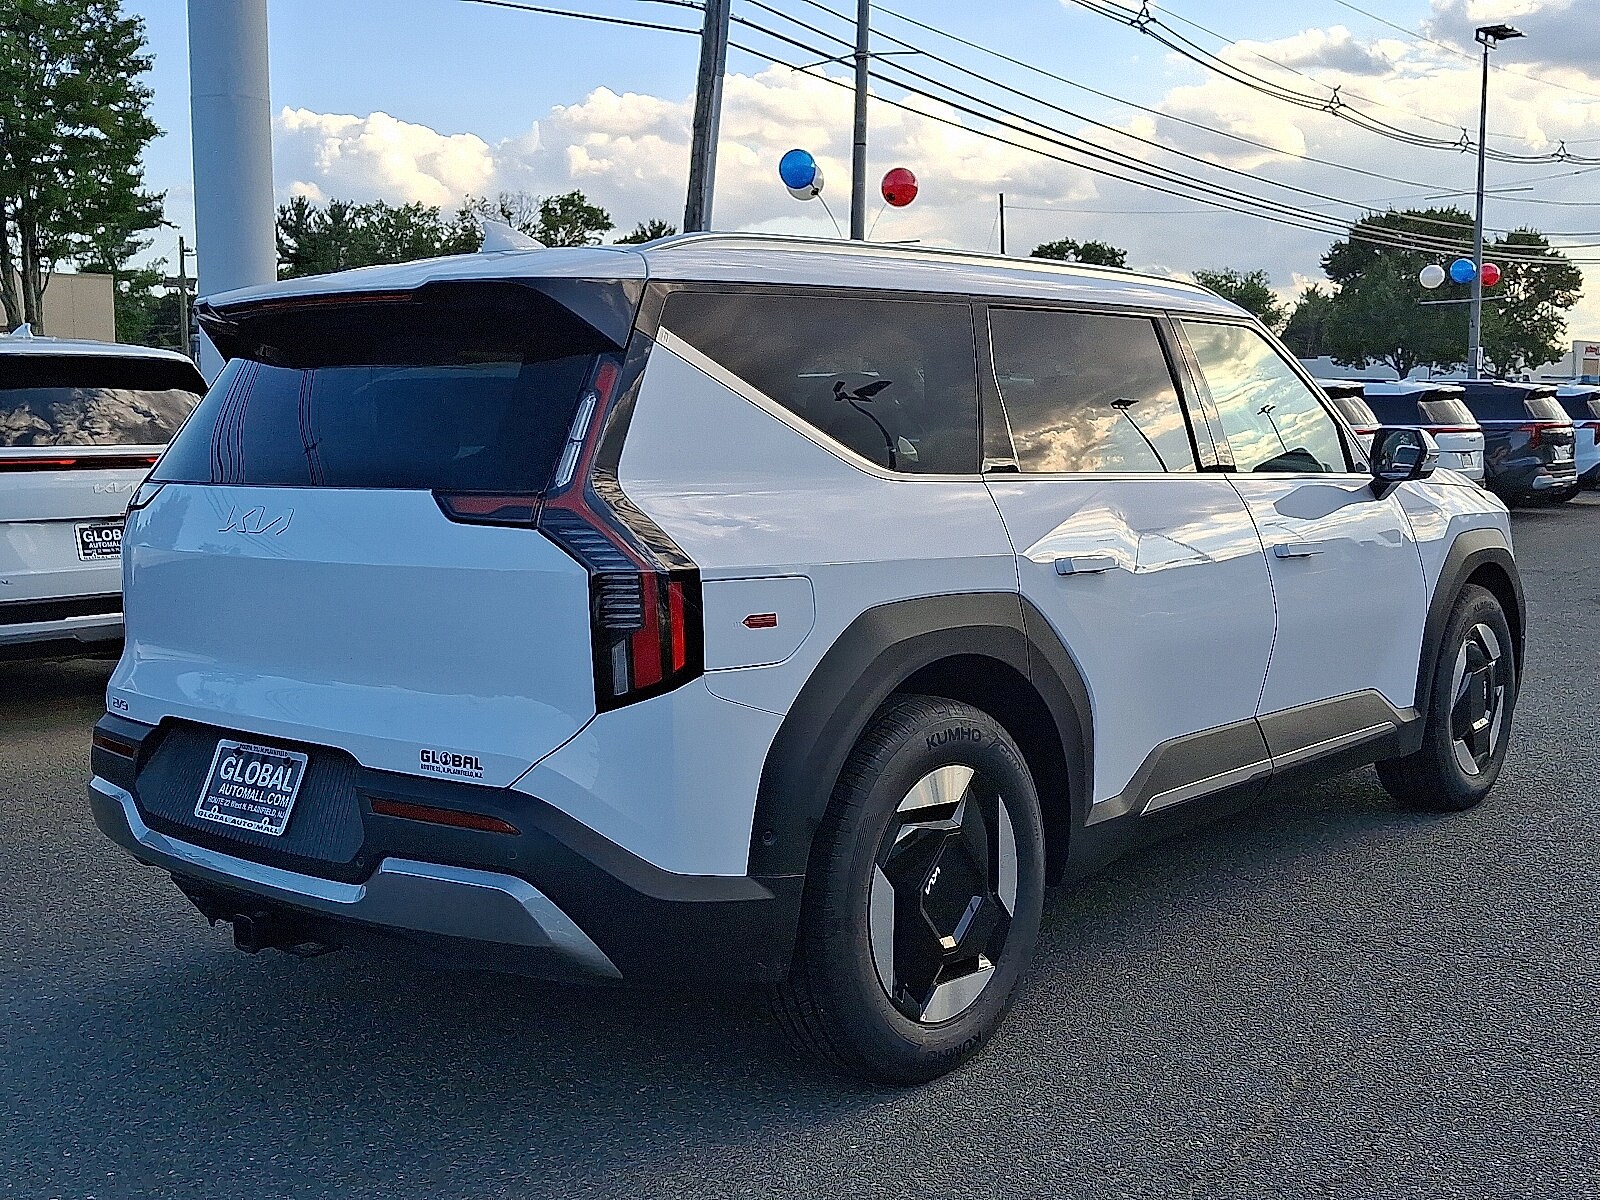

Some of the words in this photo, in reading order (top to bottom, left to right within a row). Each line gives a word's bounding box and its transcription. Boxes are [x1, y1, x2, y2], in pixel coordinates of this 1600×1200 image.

[218, 505, 296, 536] KIA
[82, 528, 122, 543] GLOB
[925, 726, 982, 752] KUMHO
[419, 748, 484, 771] GLOBAL
[220, 756, 293, 793] GLOBAL
[218, 782, 290, 808] AUTOMALL.COM
[197, 810, 229, 823] GLOBAL
[230, 818, 254, 828] AUTO
[255, 824, 280, 834] MALL
